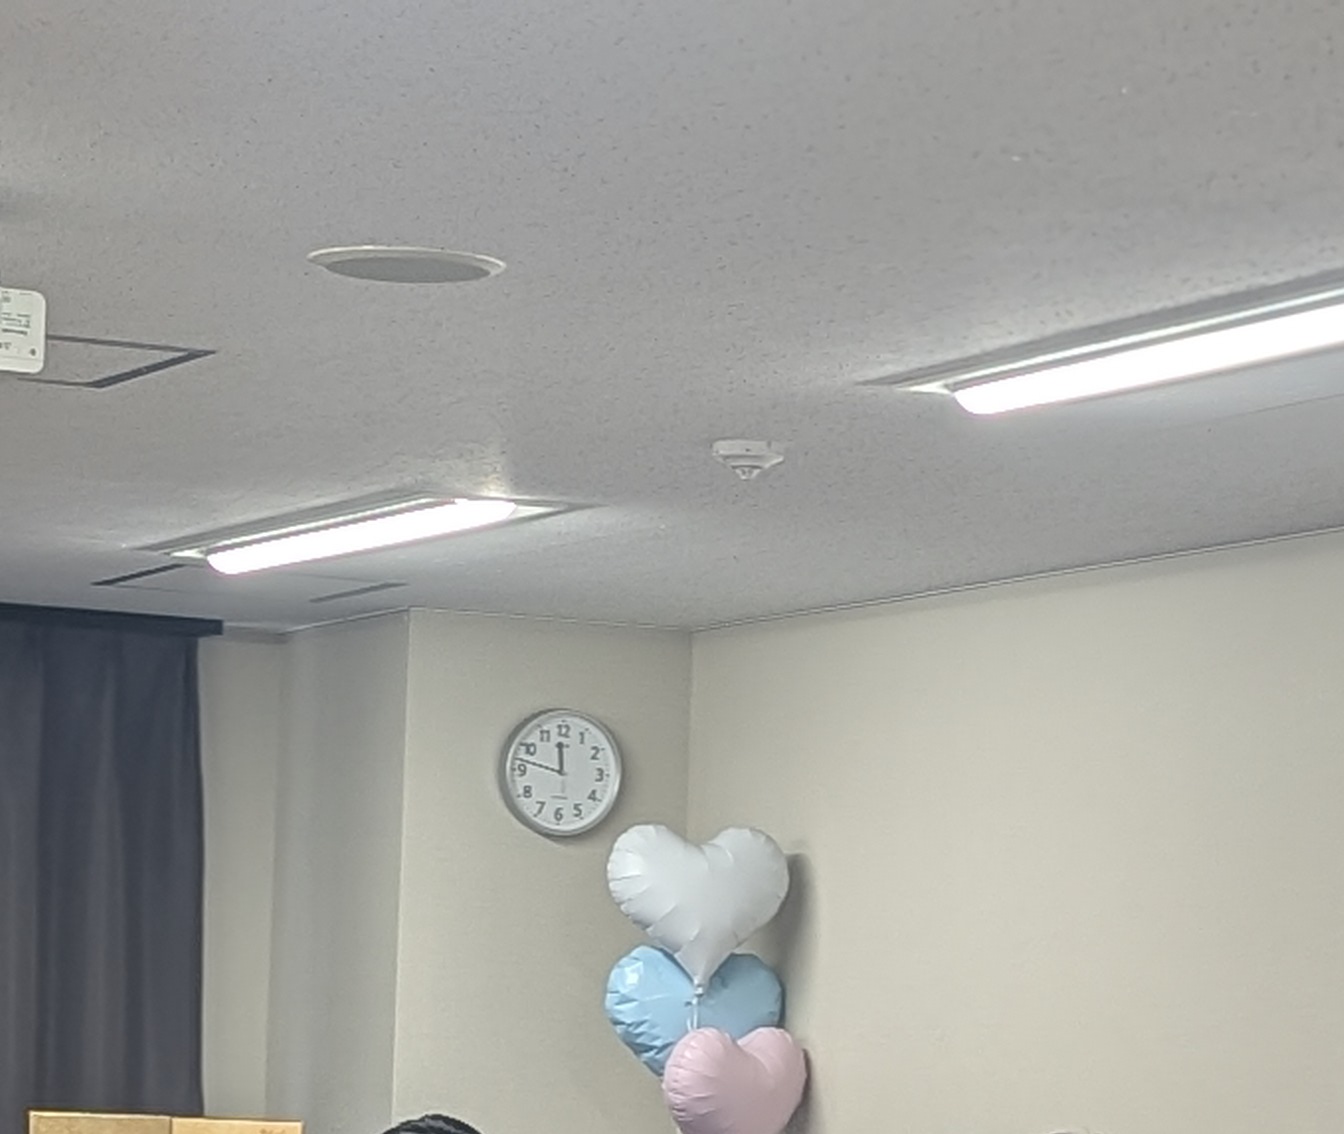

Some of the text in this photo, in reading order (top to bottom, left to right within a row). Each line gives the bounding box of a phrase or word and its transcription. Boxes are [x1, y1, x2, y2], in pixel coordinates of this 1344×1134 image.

[539, 730, 551, 742] 11
[557, 724, 571, 738] 12
[578, 732, 585, 744] 1
[524, 742, 537, 756] 10
[590, 746, 600, 760] 2
[517, 763, 527, 777] 9
[595, 768, 604, 782] 3
[523, 785, 533, 798] 8
[587, 789, 597, 802] 4
[536, 801, 546, 815] 7
[554, 807, 563, 822] 6
[573, 803, 583, 817] 5
